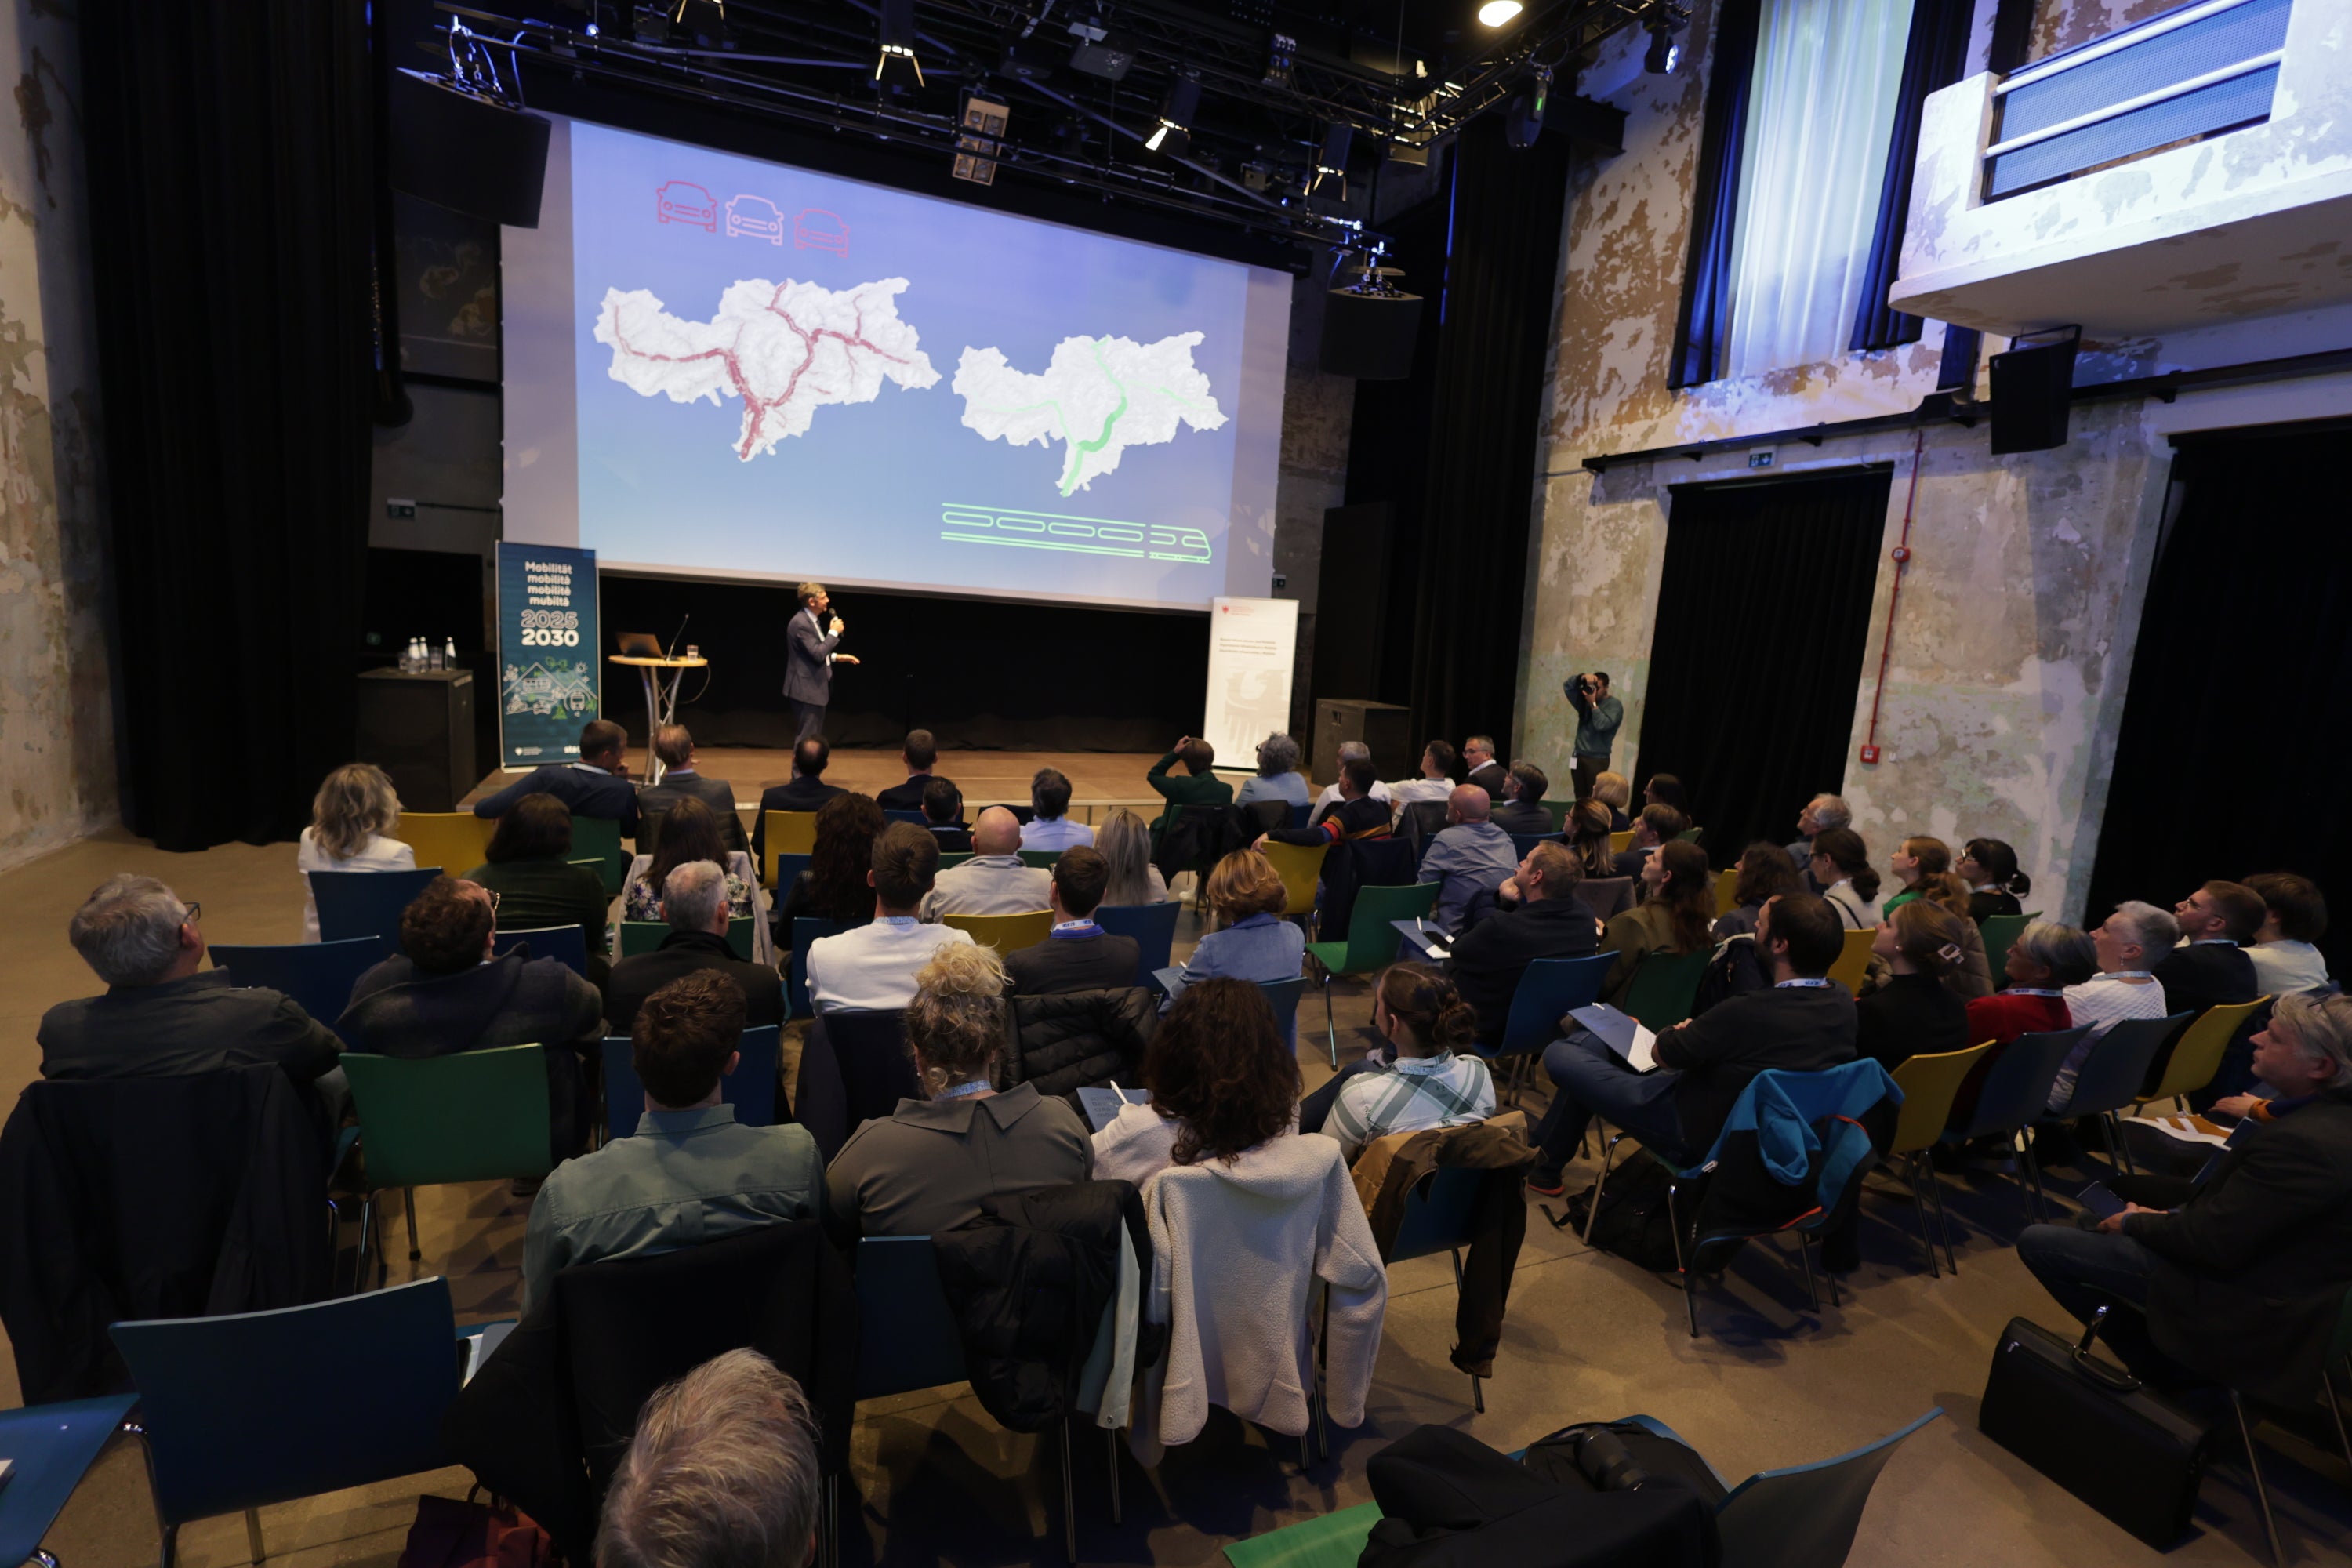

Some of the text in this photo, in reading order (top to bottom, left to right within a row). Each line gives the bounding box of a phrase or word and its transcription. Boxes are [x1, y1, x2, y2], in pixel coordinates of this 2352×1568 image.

[524, 561, 573, 575] Mobilität
[527, 574, 571, 586] mobilità
[521, 608, 579, 630] 2025
[521, 628, 579, 647] 2030
